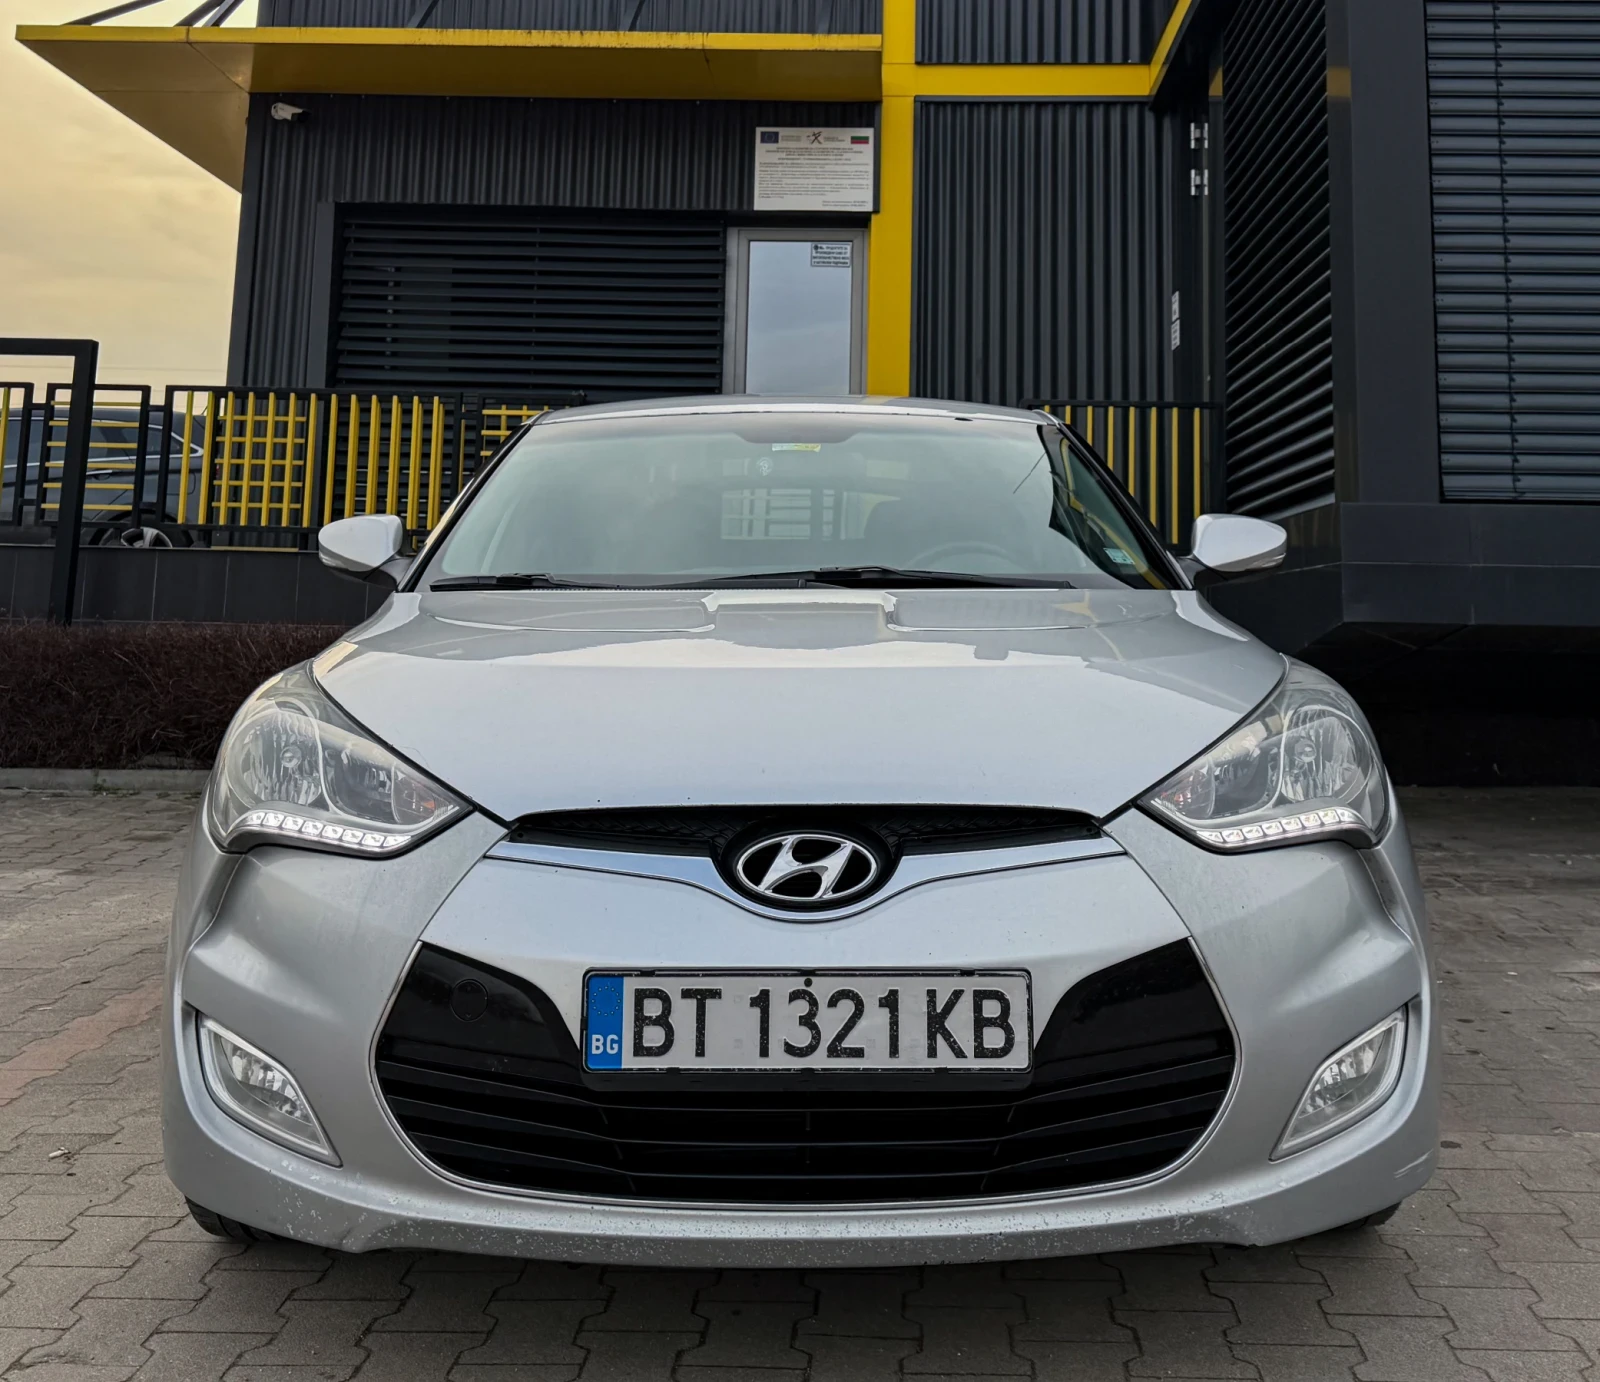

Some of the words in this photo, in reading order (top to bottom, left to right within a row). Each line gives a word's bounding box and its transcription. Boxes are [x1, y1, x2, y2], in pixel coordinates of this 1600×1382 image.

[591, 1034, 619, 1055] BG
[633, 988, 722, 1058] BT
[749, 988, 900, 1059] 1321
[926, 988, 1016, 1059] KB
